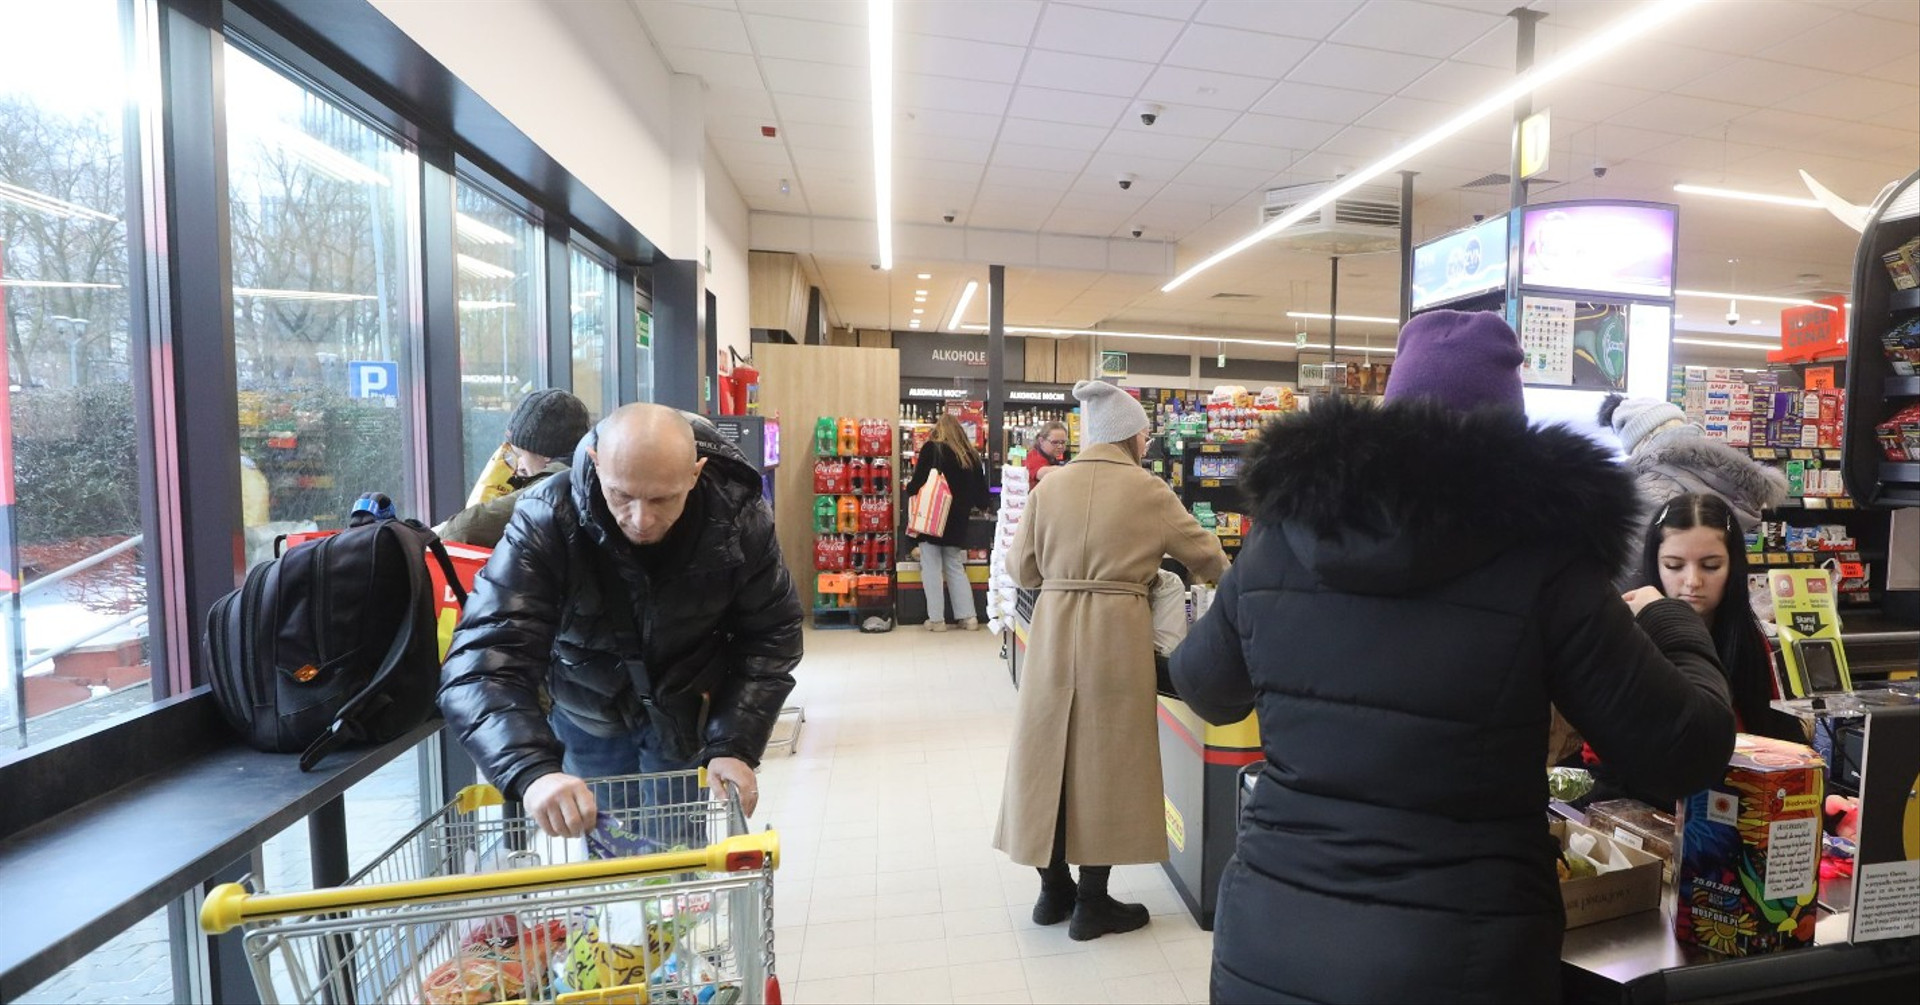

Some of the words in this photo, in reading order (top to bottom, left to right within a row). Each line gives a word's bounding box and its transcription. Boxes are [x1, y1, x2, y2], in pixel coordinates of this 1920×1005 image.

[932, 349, 986, 362] ALKOHOLE
[360, 365, 387, 398] P
[1800, 624, 1815, 633] Tutaj
[1692, 877, 1742, 895] 25.01.2026
